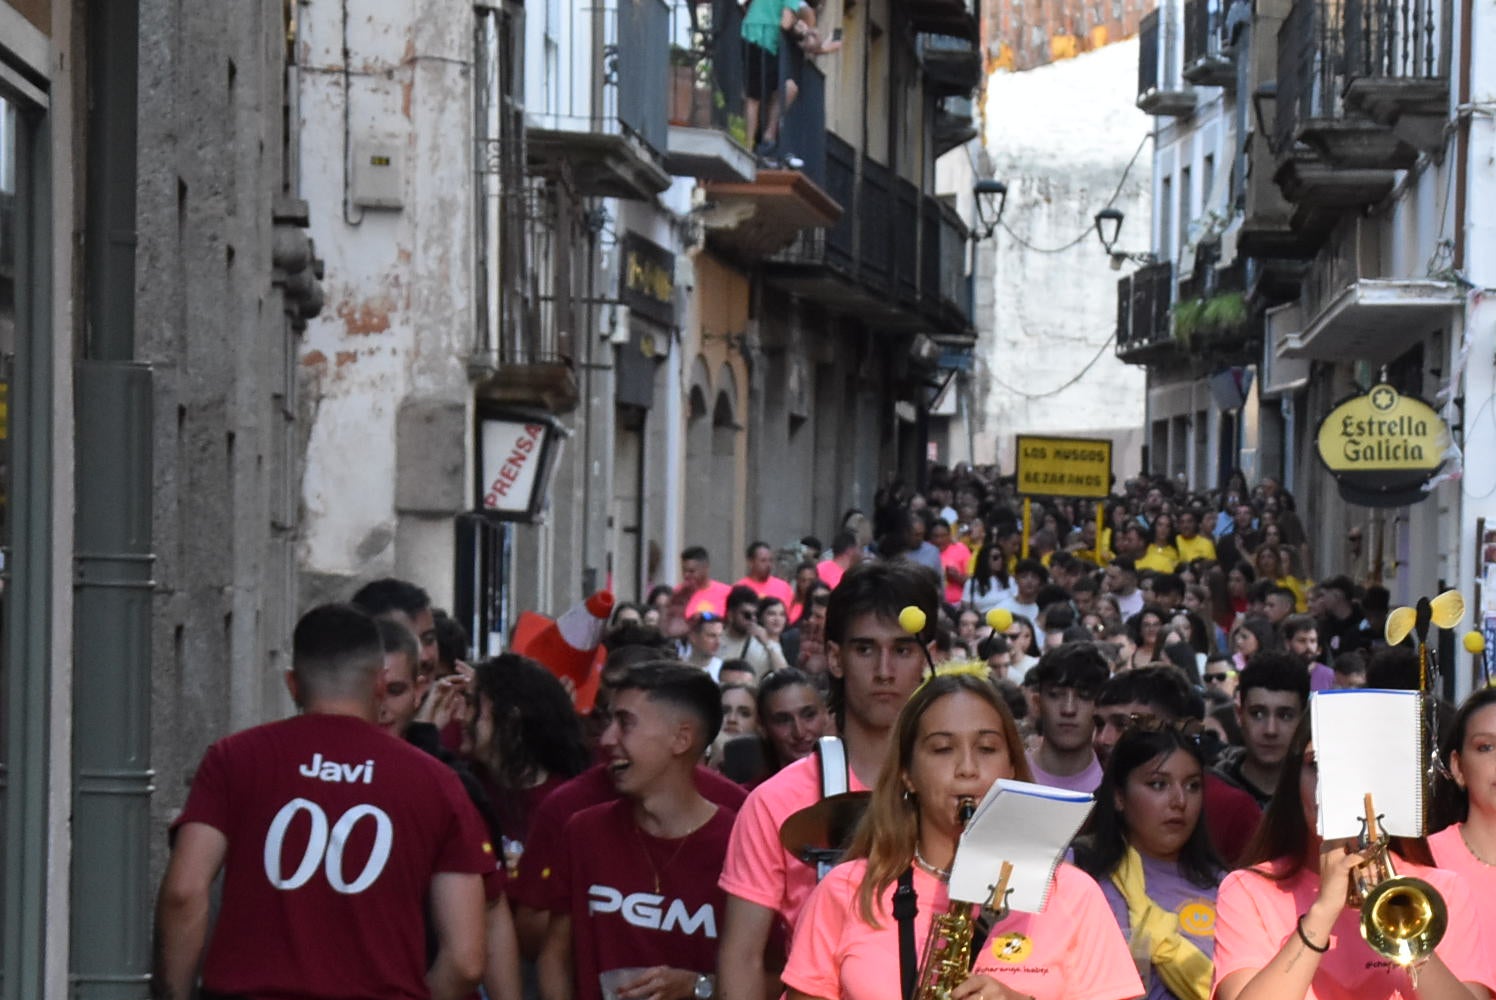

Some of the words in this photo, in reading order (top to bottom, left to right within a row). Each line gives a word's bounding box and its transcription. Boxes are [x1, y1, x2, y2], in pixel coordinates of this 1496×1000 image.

[1341, 415, 1427, 437] Estrella
[1024, 447, 1047, 459] LOS
[1344, 438, 1423, 461] Galicia
[483, 424, 543, 508] PRENSA
[299, 753, 375, 784] Javi
[264, 797, 394, 894] 00
[588, 884, 717, 938] PGM
